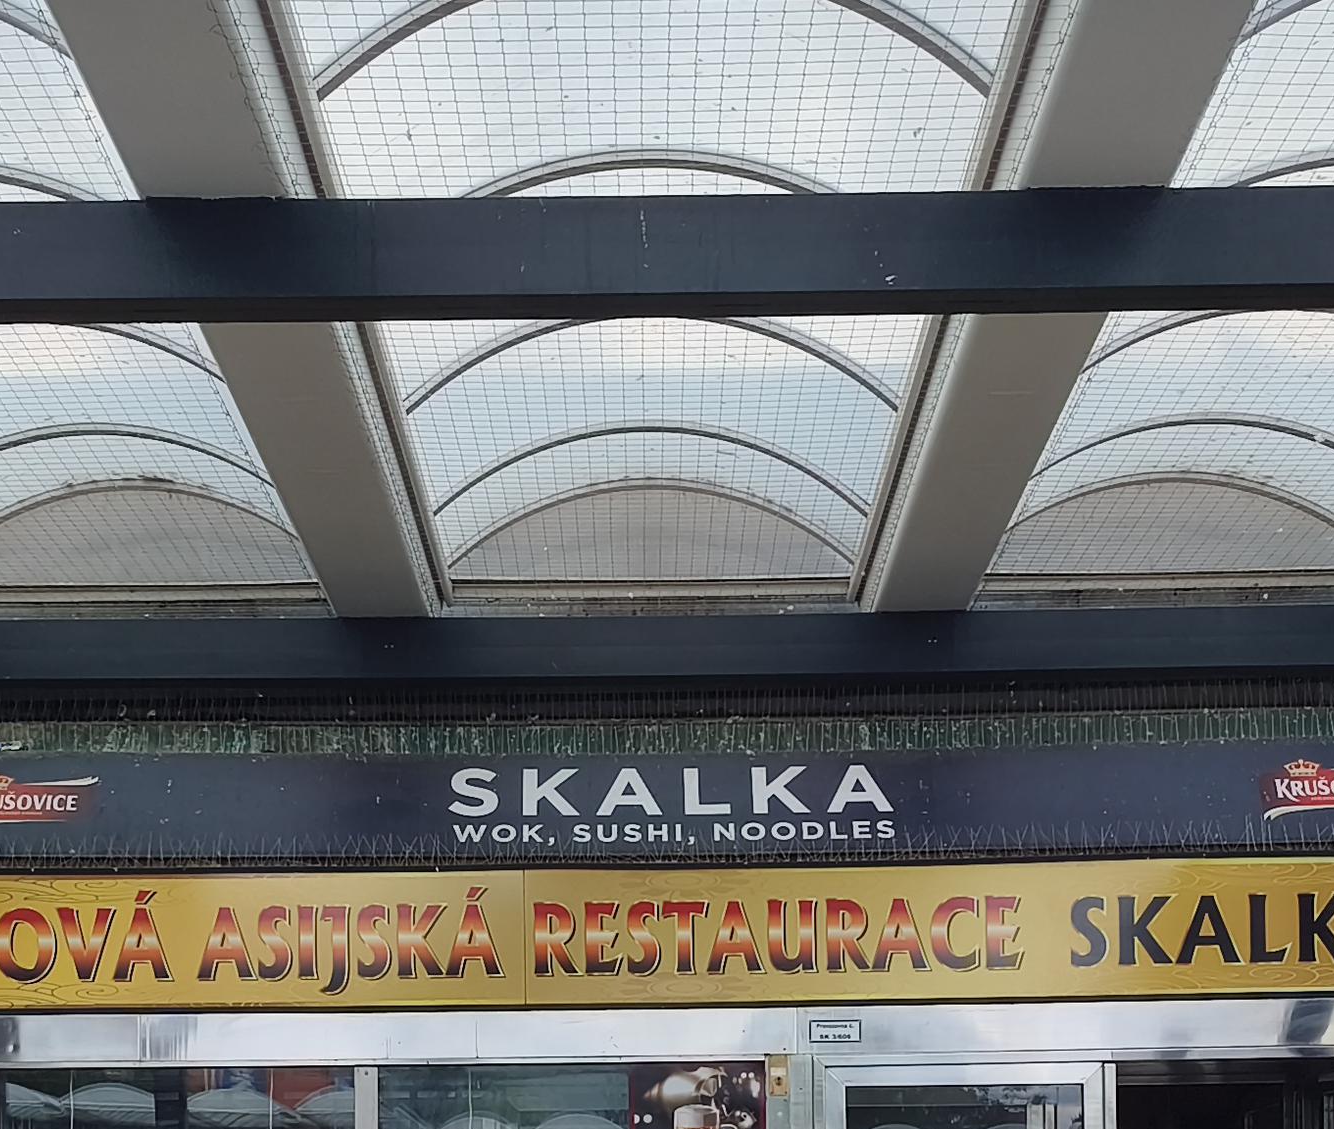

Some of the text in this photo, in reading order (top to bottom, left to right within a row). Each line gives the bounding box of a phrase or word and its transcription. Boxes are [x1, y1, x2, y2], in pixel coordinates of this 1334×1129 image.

[447, 764, 895, 818] SKALKA
[452, 819, 896, 847] WOK, SUSHI, NOODLES
[197, 885, 505, 996] ASIJSKÁ
[532, 893, 1026, 979] RESTAURACE
